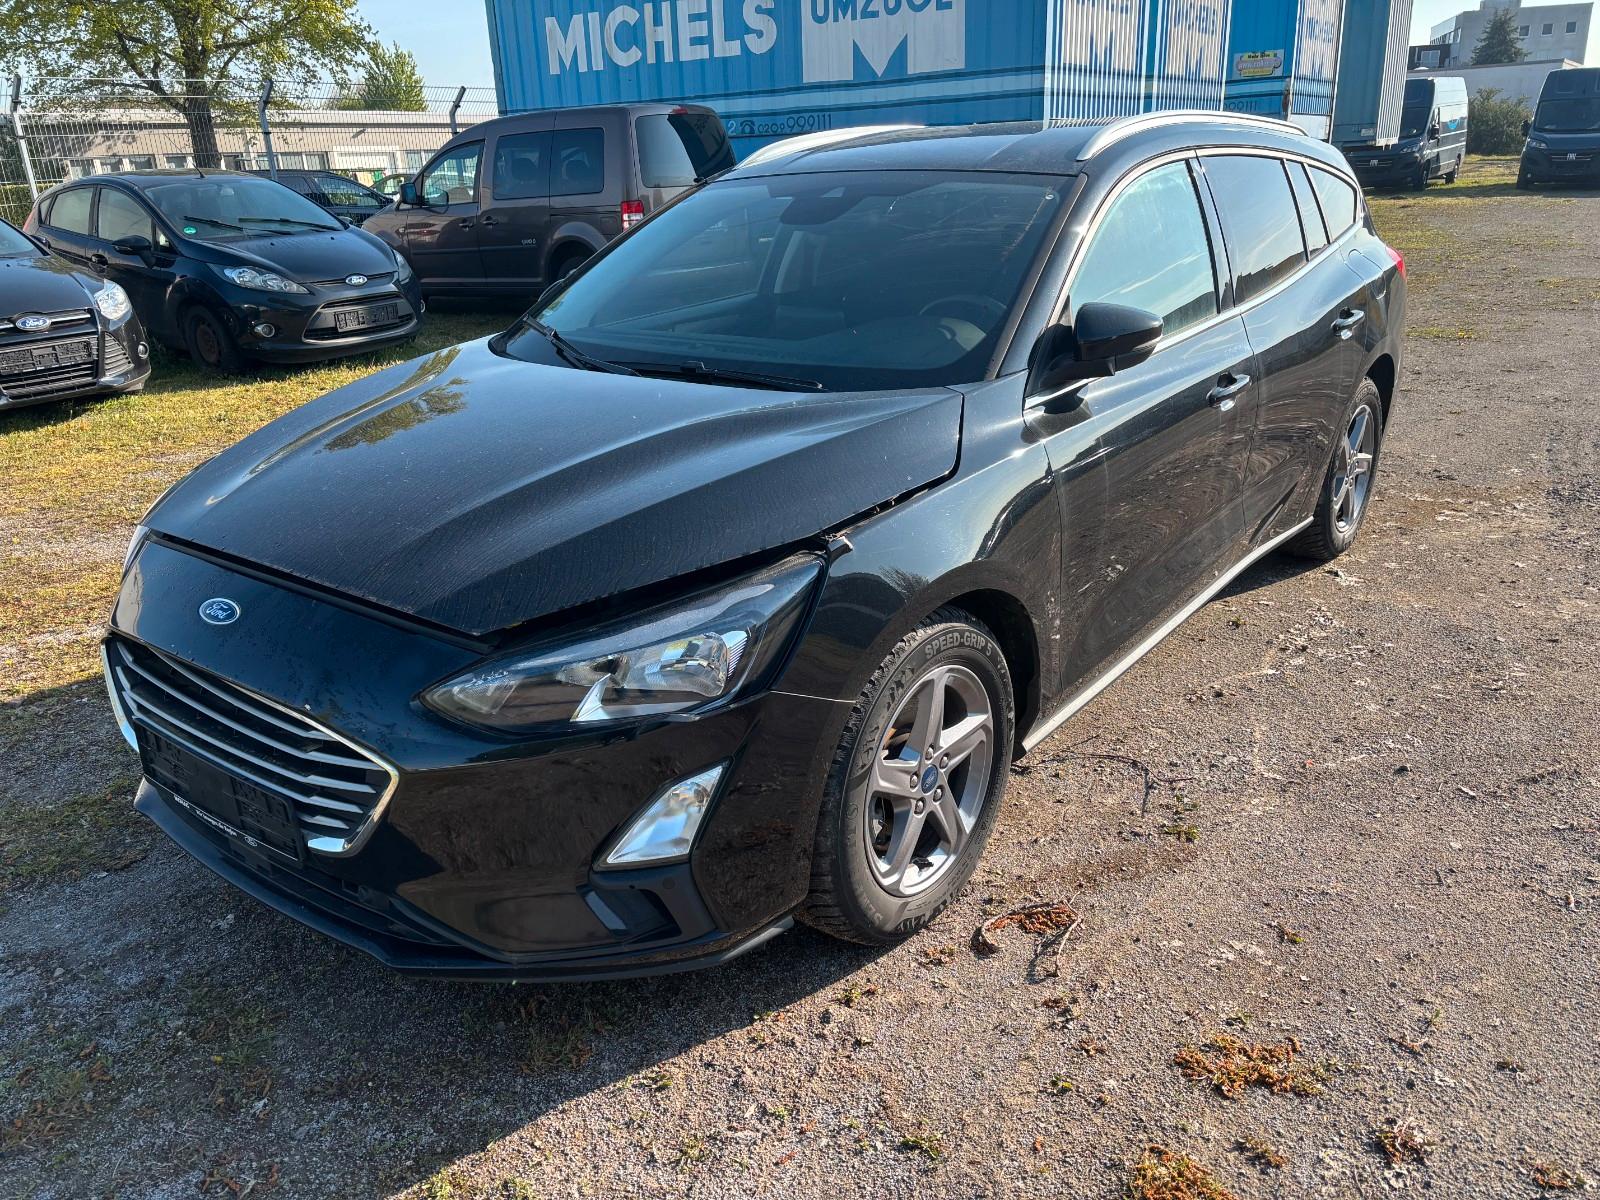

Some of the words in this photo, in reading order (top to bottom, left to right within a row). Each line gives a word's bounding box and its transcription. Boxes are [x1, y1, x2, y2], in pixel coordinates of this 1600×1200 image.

[544, 0, 777, 75] MICHELS
[786, 113, 832, 131] 999111
[205, 602, 232, 620] Ford
[985, 643, 993, 656] 5
